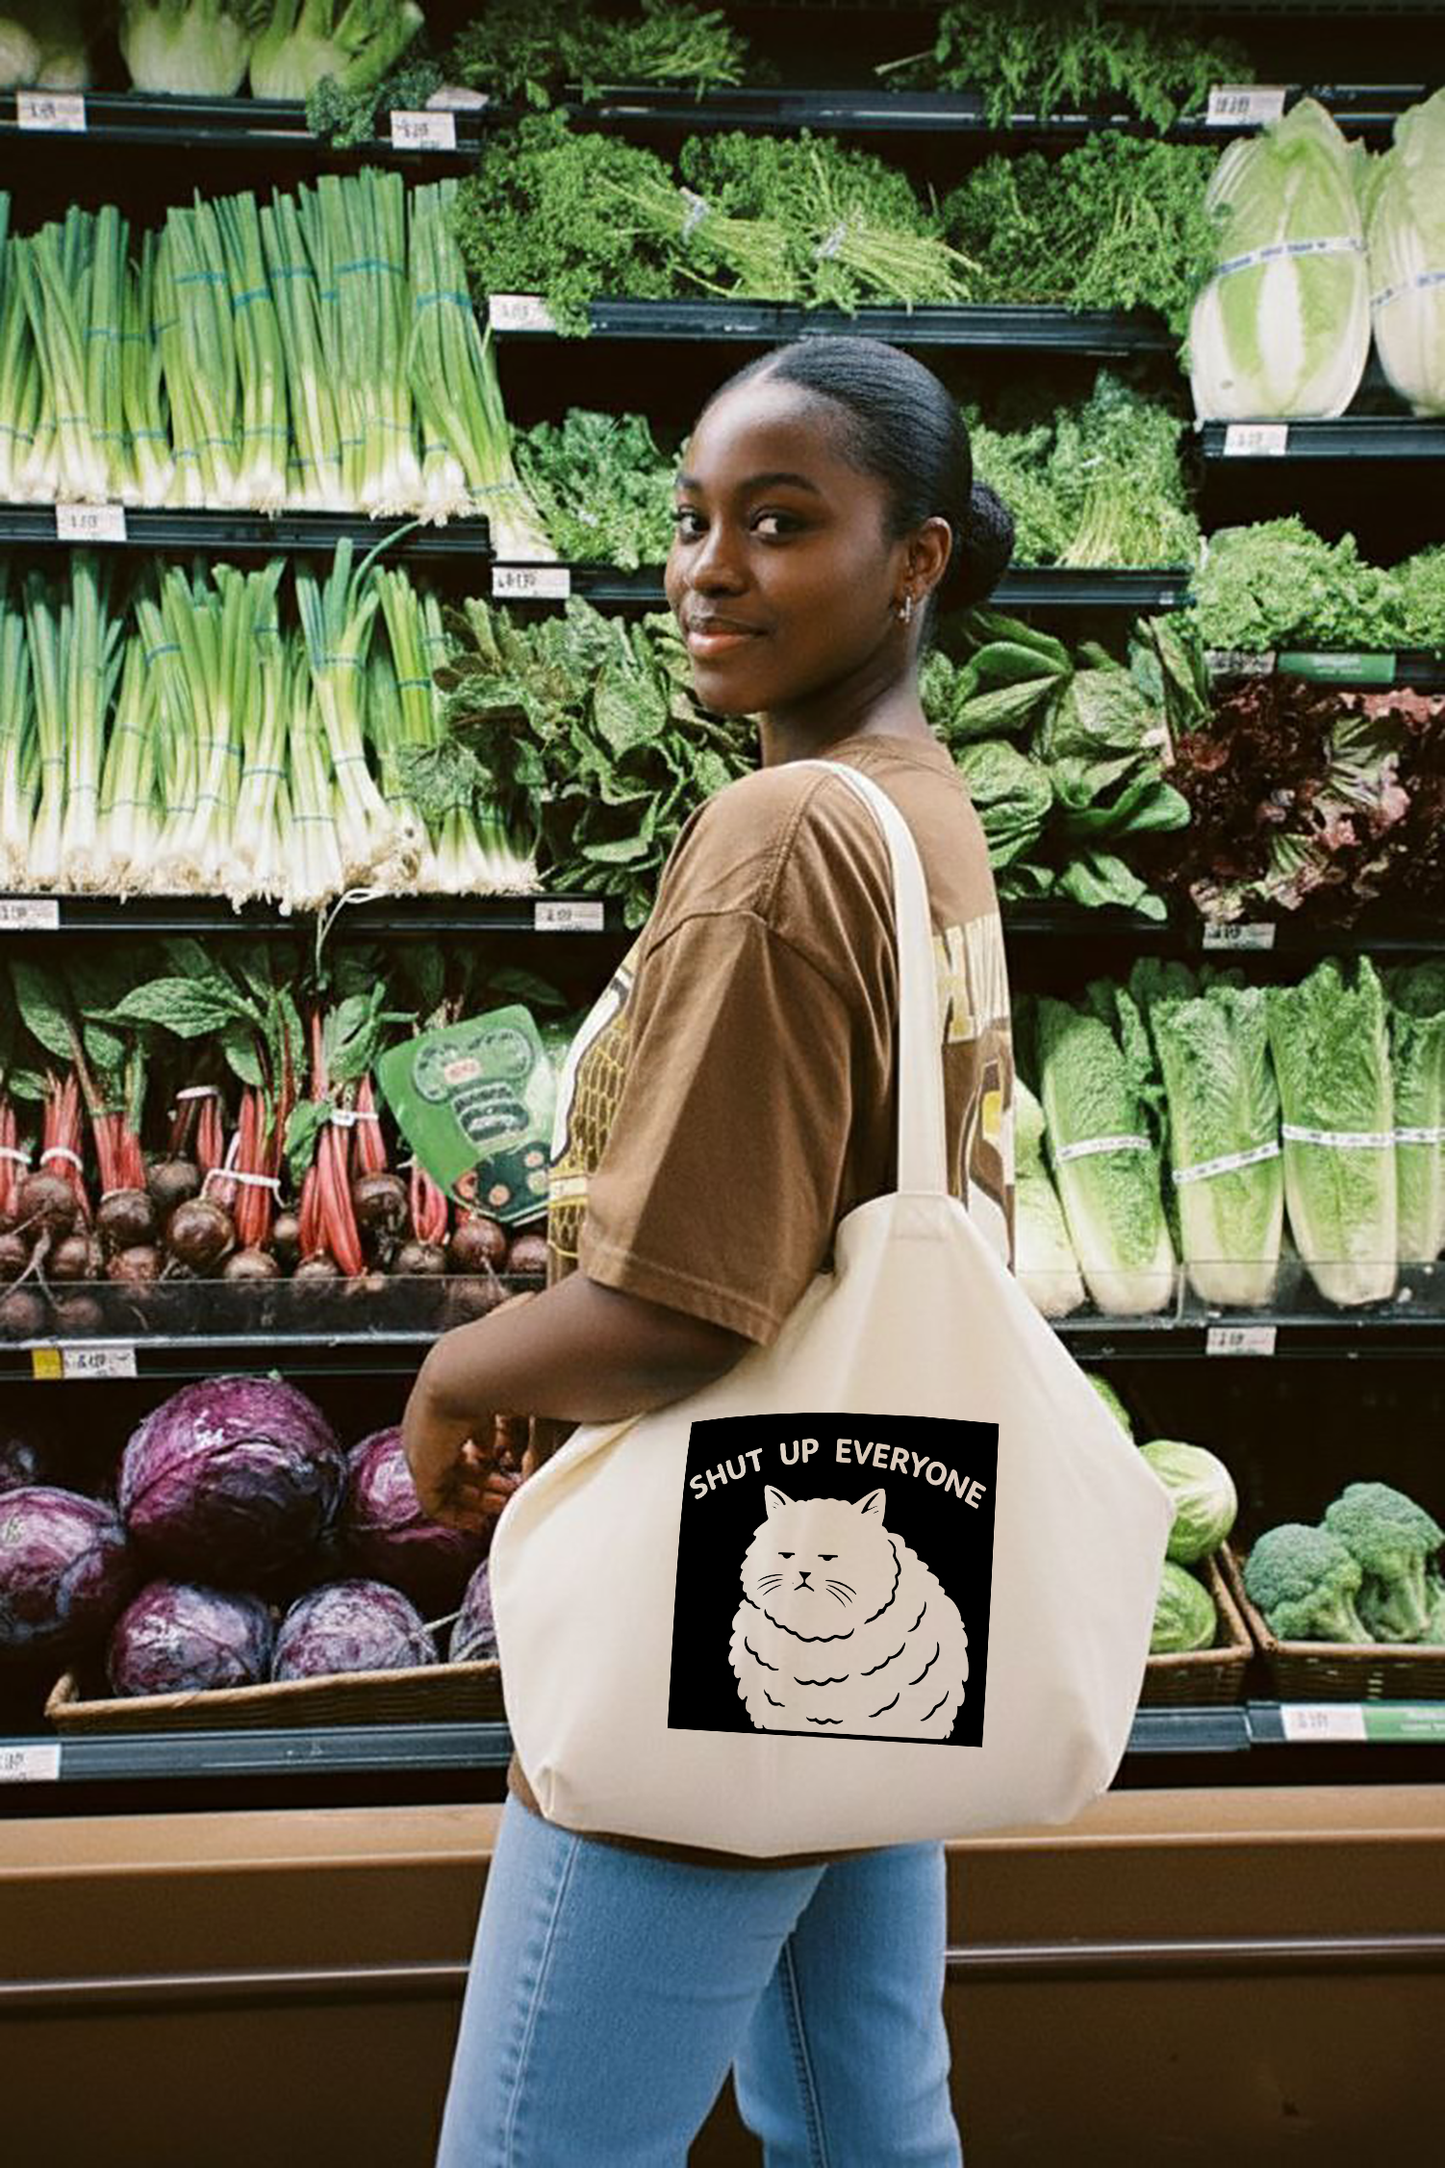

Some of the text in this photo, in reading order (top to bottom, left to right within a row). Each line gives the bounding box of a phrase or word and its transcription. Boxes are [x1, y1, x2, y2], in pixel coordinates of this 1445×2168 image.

[689, 1438, 987, 1510] SHUT UP EVERYONE
